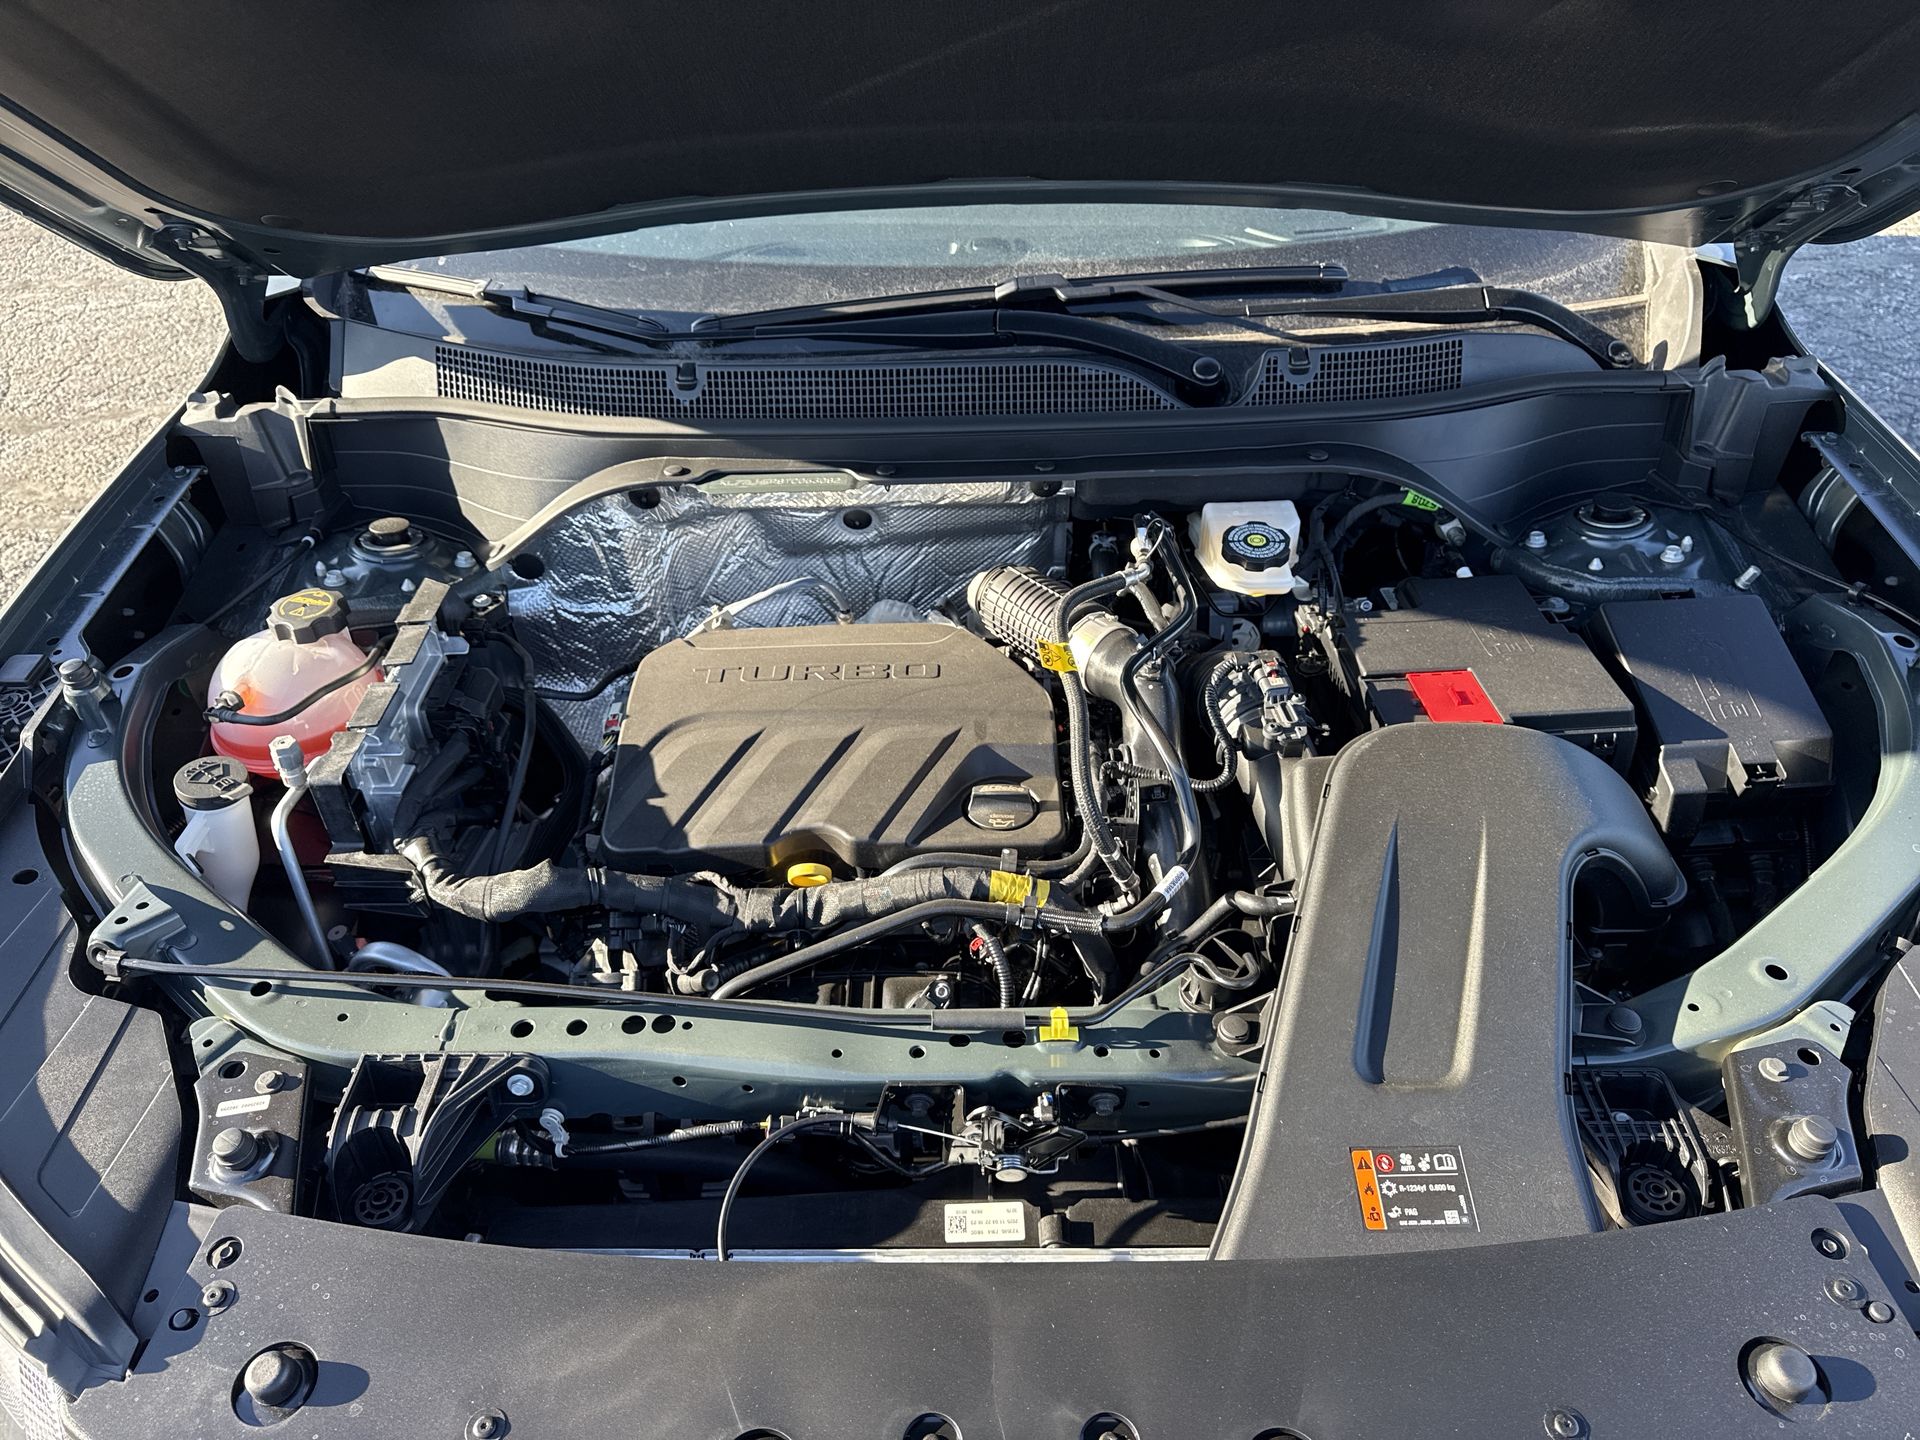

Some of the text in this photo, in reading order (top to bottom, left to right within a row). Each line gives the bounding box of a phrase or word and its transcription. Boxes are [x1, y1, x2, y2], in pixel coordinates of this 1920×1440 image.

[693, 663, 942, 684] TURBO
[979, 784, 1025, 793] ACDelco
[1399, 1184, 1427, 1193] R-1234yf
[1447, 1183, 1456, 1193] kg
[1404, 1208, 1418, 1216] PAG
